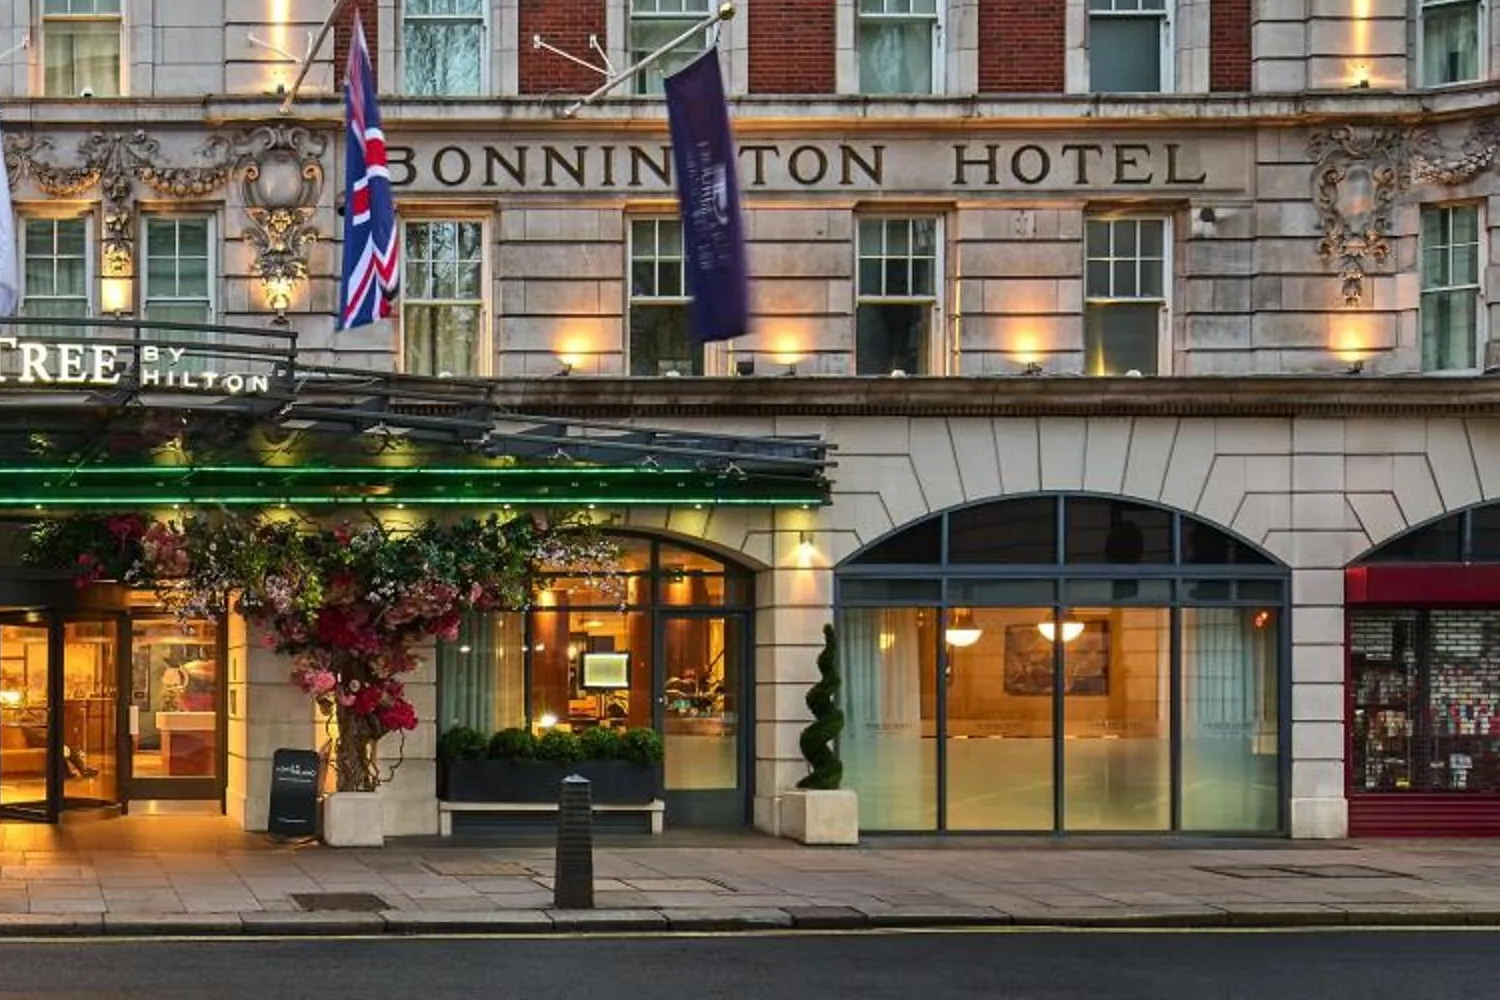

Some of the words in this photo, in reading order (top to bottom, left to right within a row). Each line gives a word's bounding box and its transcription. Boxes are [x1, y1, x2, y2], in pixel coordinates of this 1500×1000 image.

[385, 145, 886, 187] BONNINTON
[952, 144, 1207, 186] HOTEL
[143, 346, 185, 362] BY
[143, 369, 269, 393] HILTON
